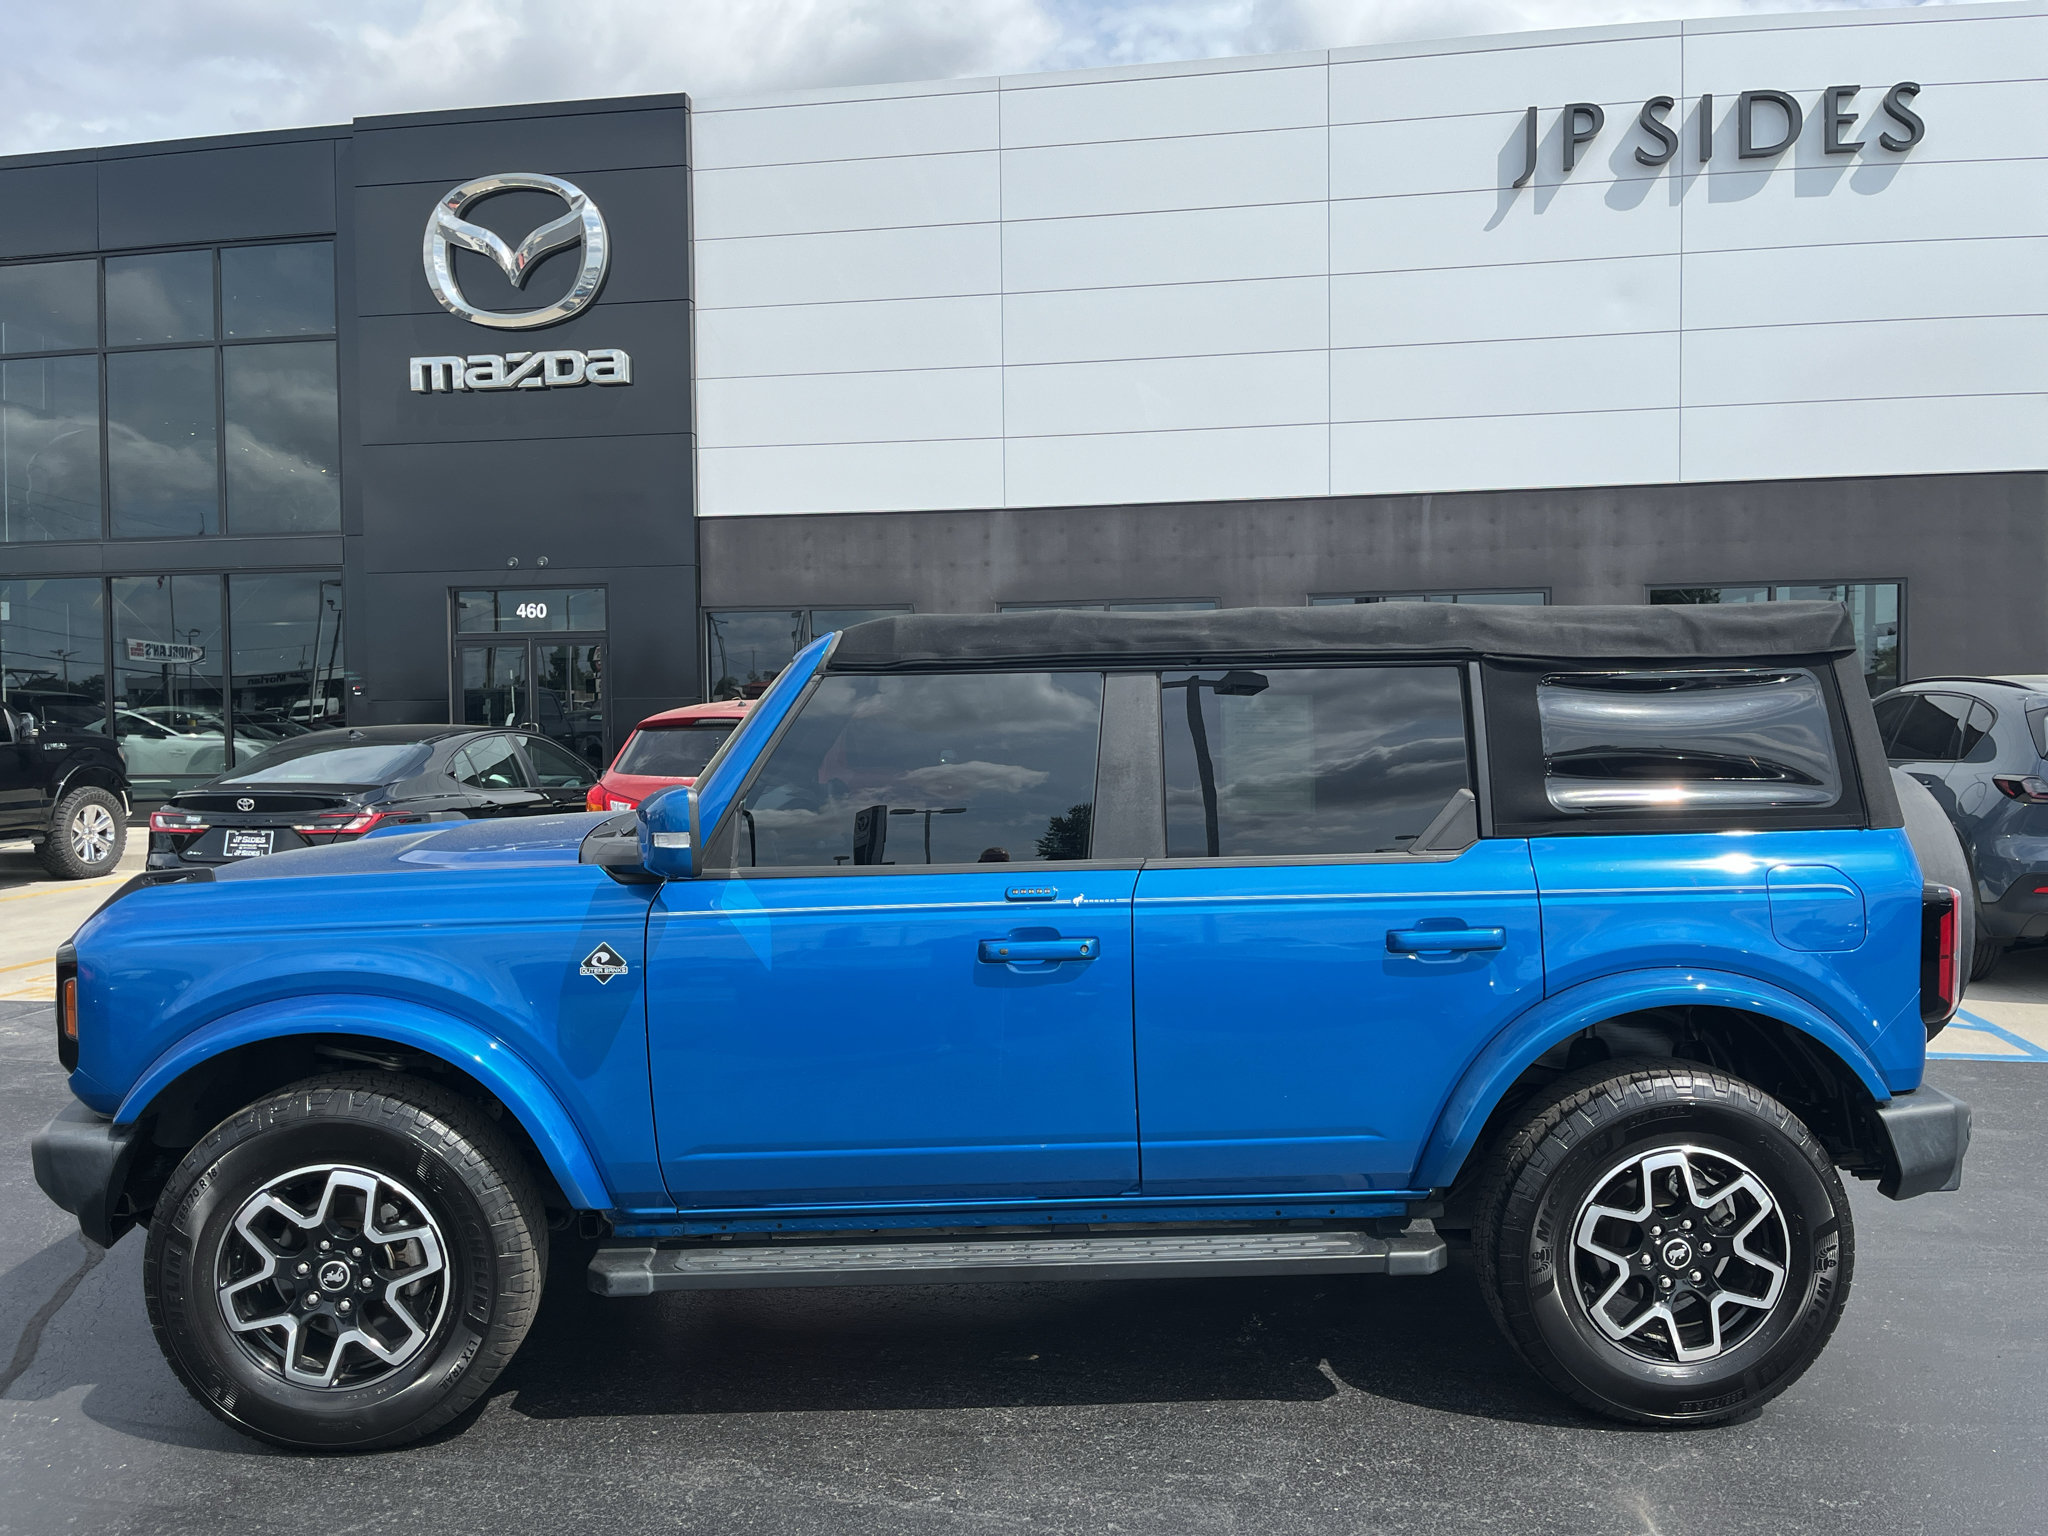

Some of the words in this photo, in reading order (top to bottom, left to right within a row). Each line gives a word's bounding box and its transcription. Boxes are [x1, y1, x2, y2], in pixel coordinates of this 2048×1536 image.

[1512, 103, 1605, 189] JP
[1635, 81, 1926, 167] SIDES
[410, 349, 633, 392] mazda
[516, 603, 547, 619] 460
[198, 1178, 208, 1190] R
[206, 1167, 218, 1181] 18
[460, 1339, 478, 1363] LTX
[439, 1363, 465, 1390] TRAIL
